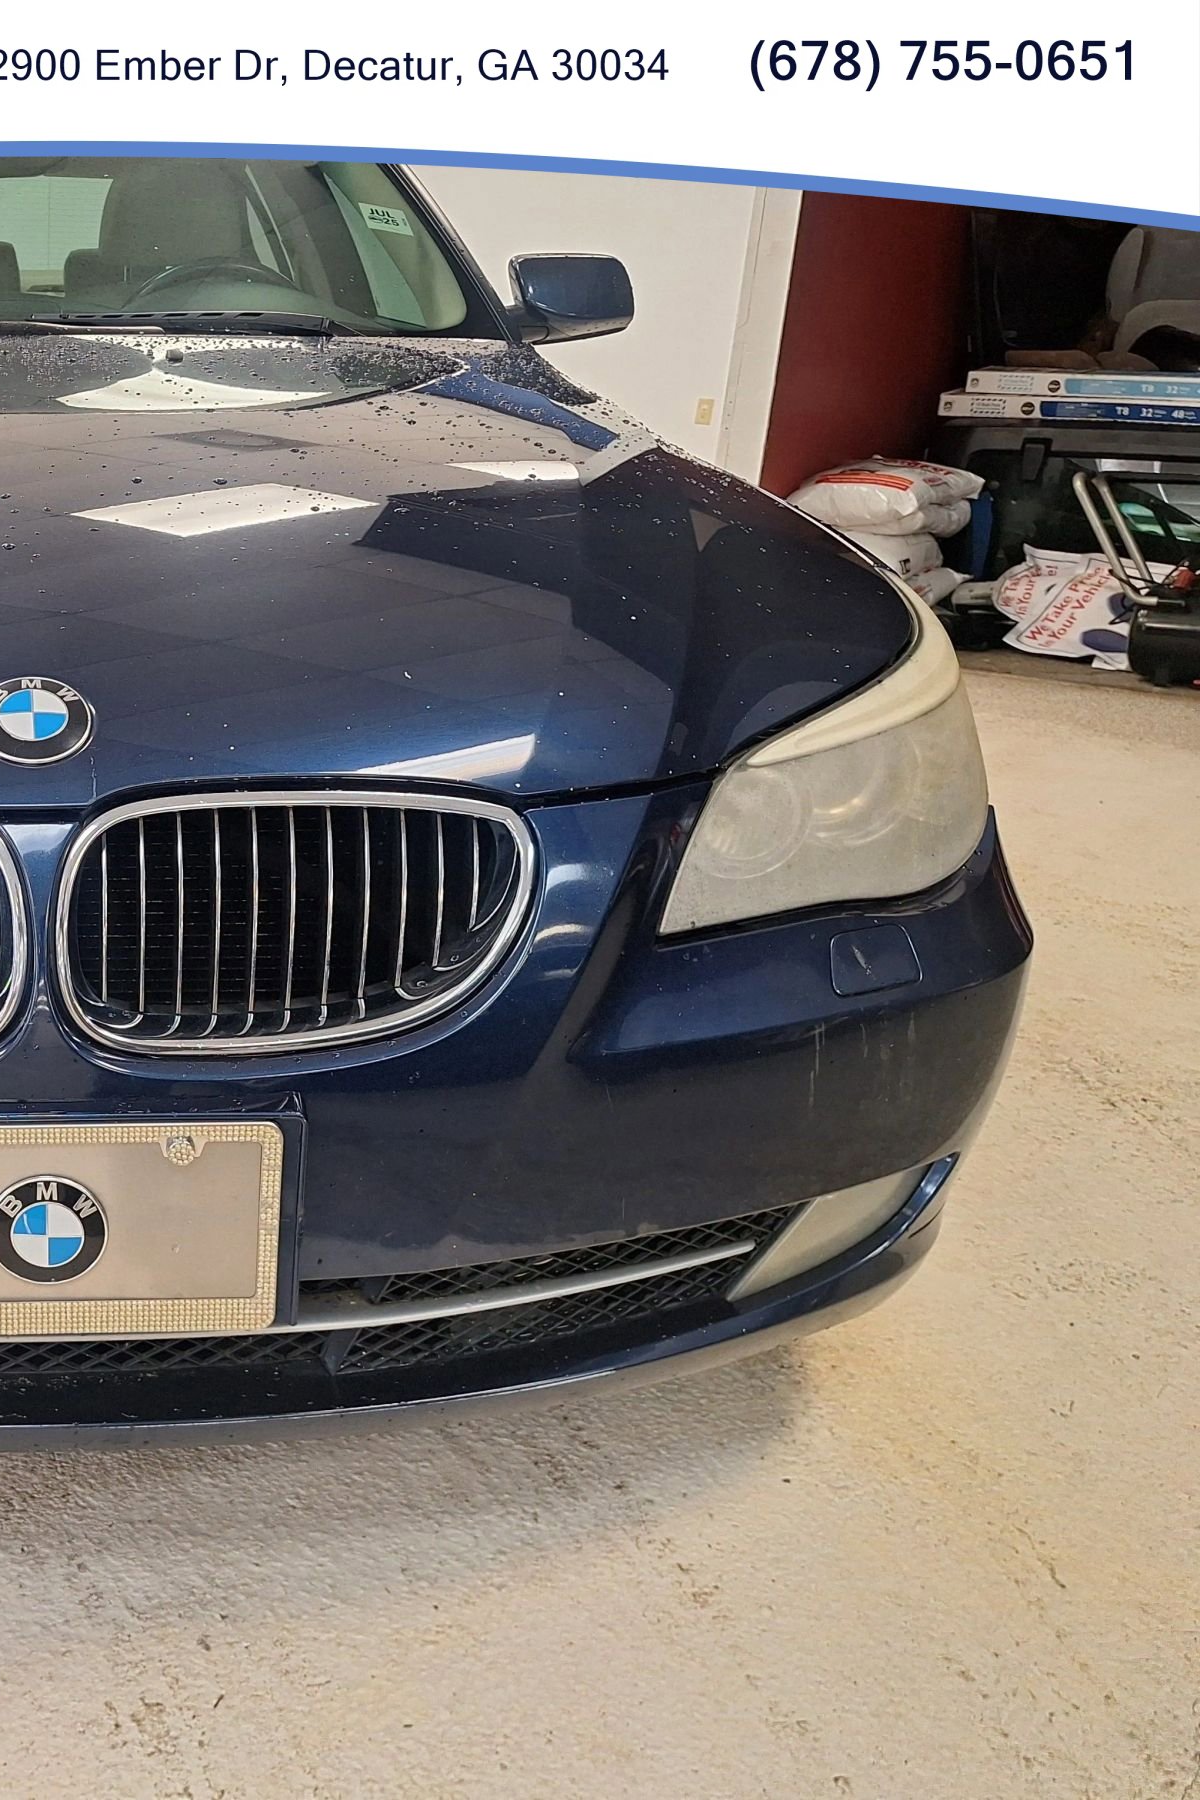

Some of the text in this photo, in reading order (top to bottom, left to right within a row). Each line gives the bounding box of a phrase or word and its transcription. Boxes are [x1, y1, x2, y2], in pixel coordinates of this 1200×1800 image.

[369, 208, 395, 219] JUL
[384, 217, 400, 227] 25
[1115, 406, 1130, 416] T8
[1140, 408, 1153, 418] 32
[1048, 612, 1078, 640] Your
[1072, 572, 1112, 611] Vehicl
[1025, 625, 1050, 641] We
[1041, 595, 1073, 624] Take
